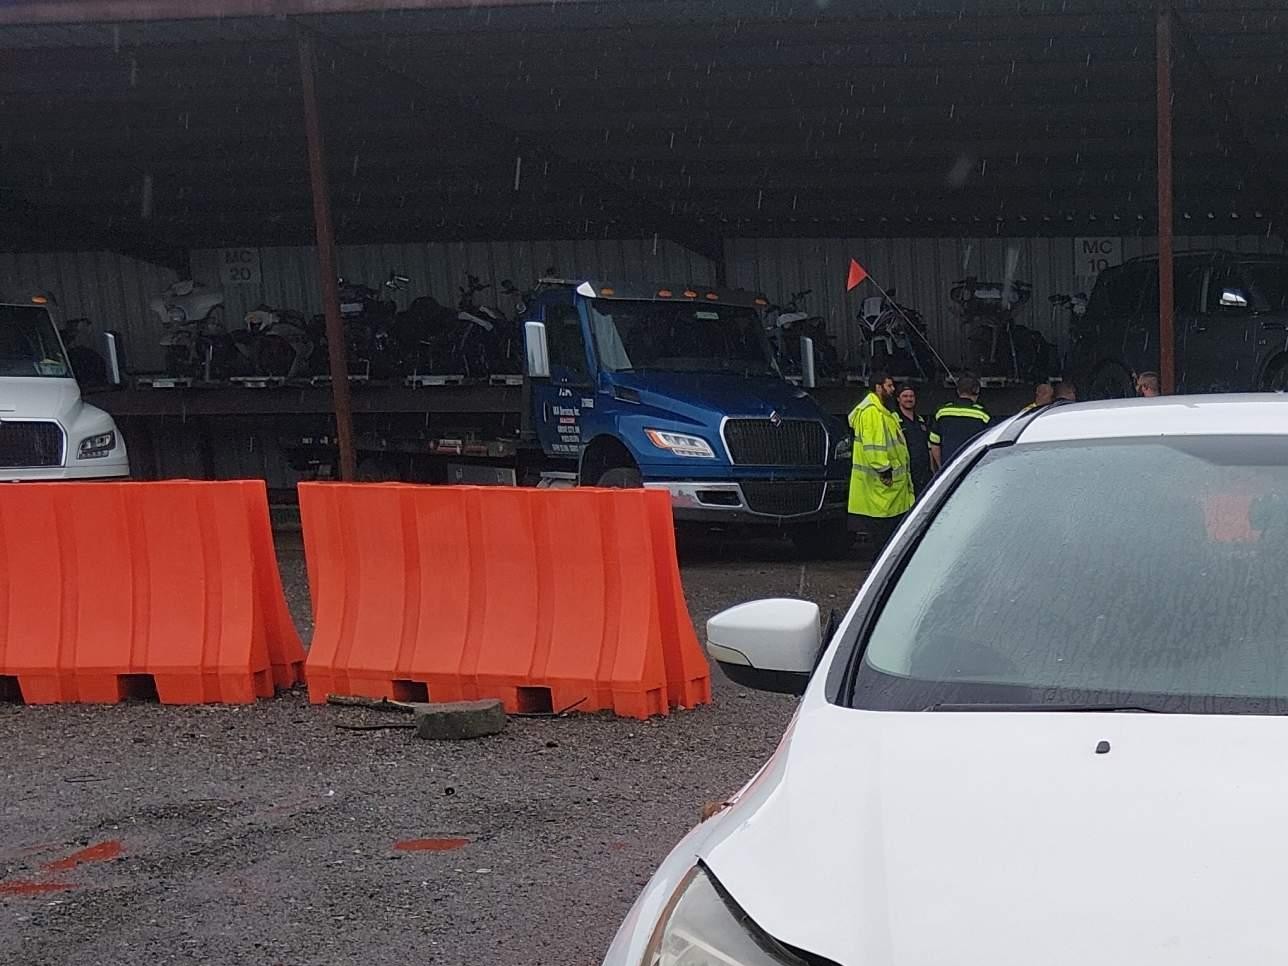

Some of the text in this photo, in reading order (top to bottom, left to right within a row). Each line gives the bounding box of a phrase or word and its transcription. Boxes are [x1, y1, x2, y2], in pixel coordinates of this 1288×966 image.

[1083, 239, 1113, 254] MC
[225, 250, 252, 263] MC
[230, 267, 251, 281] 20
